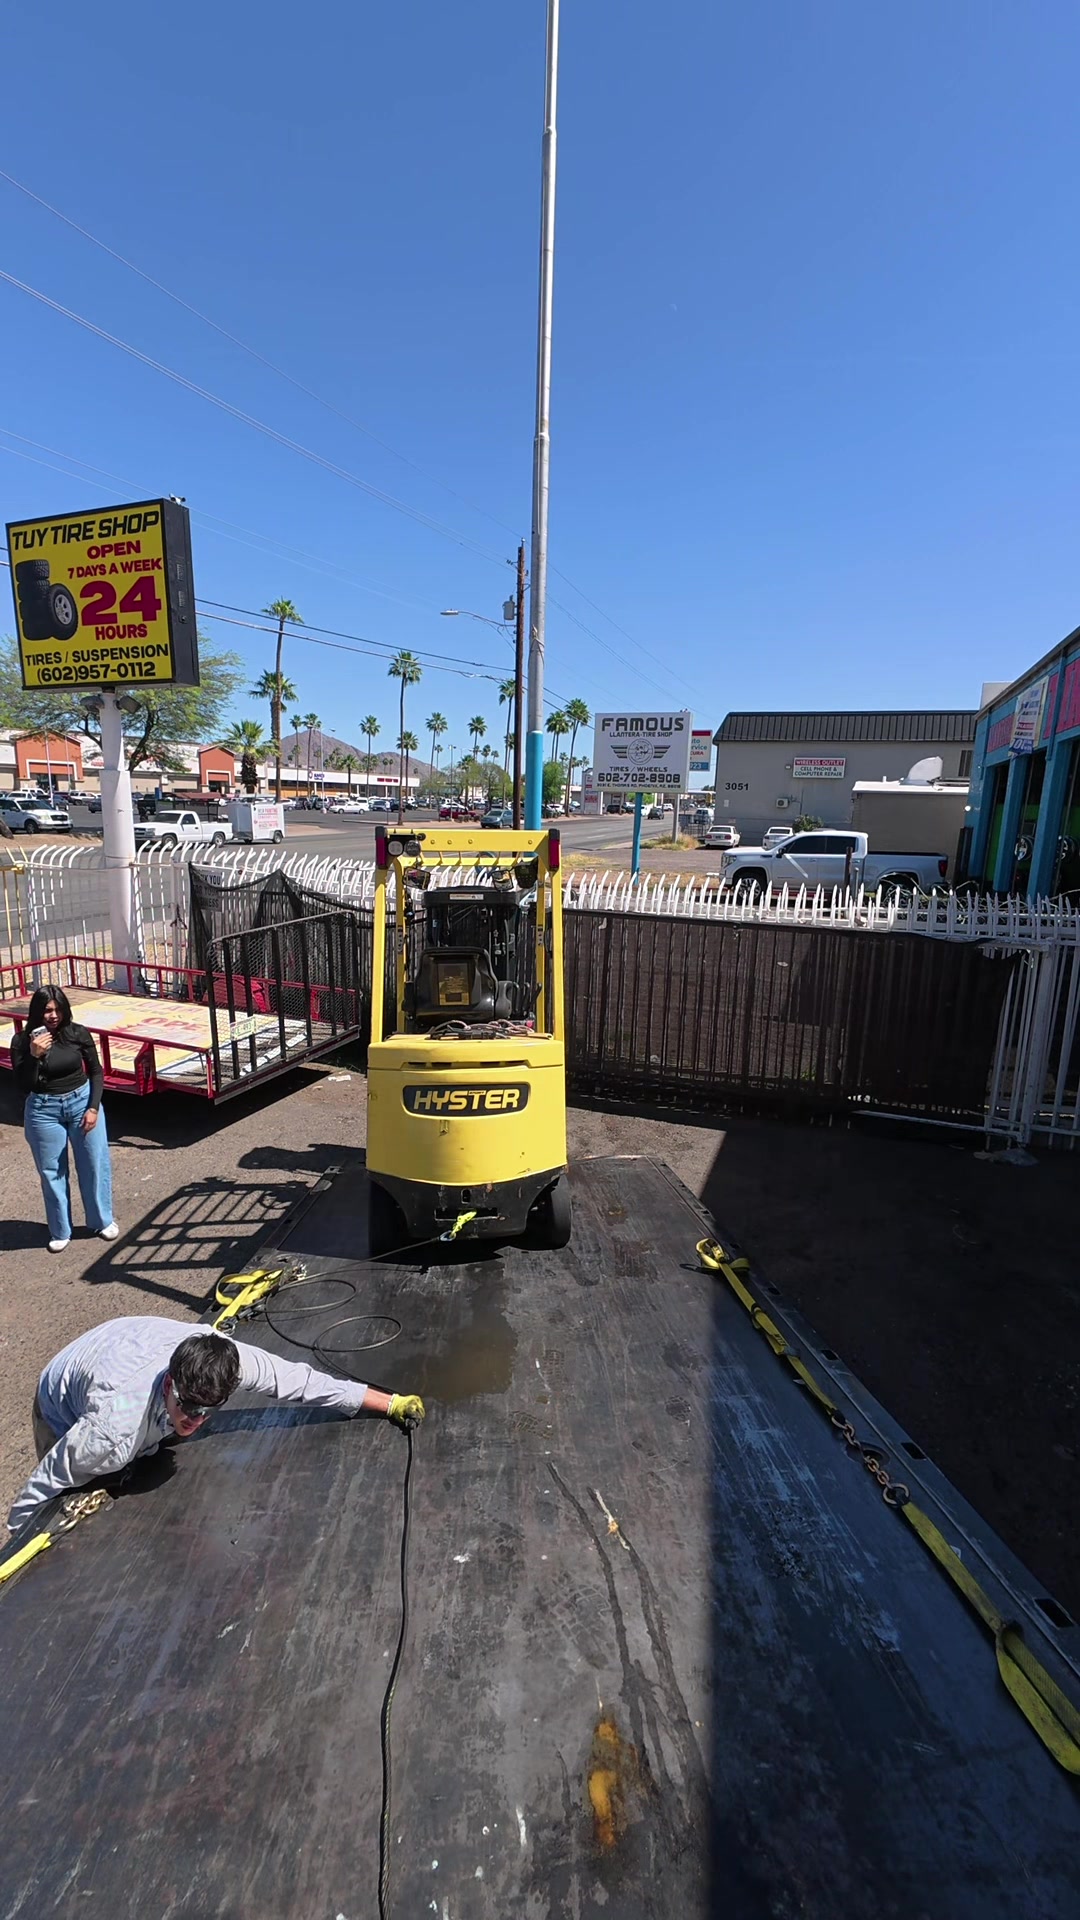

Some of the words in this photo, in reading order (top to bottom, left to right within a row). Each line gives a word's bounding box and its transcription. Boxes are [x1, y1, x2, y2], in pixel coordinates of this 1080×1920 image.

[12, 527, 50, 550] TUY
[51, 520, 96, 545] TIRE
[98, 511, 160, 538] SHOP
[87, 540, 142, 559] OPEN
[68, 568, 75, 579] 7
[77, 564, 106, 578] DAYS
[109, 563, 118, 574] A
[120, 558, 163, 573] WEEK
[79, 575, 162, 626] 24
[95, 623, 148, 641] HOURS
[25, 651, 62, 666] TIRES
[72, 643, 169, 663] SUSPENSION
[37, 661, 156, 685] (602)957-0112
[601, 717, 684, 732] FAMOUS
[597, 773, 681, 783] 602-702-8908
[724, 782, 749, 791] 3051
[209, 875, 221, 885] YOU
[413, 1088, 520, 1111] HYSTER
